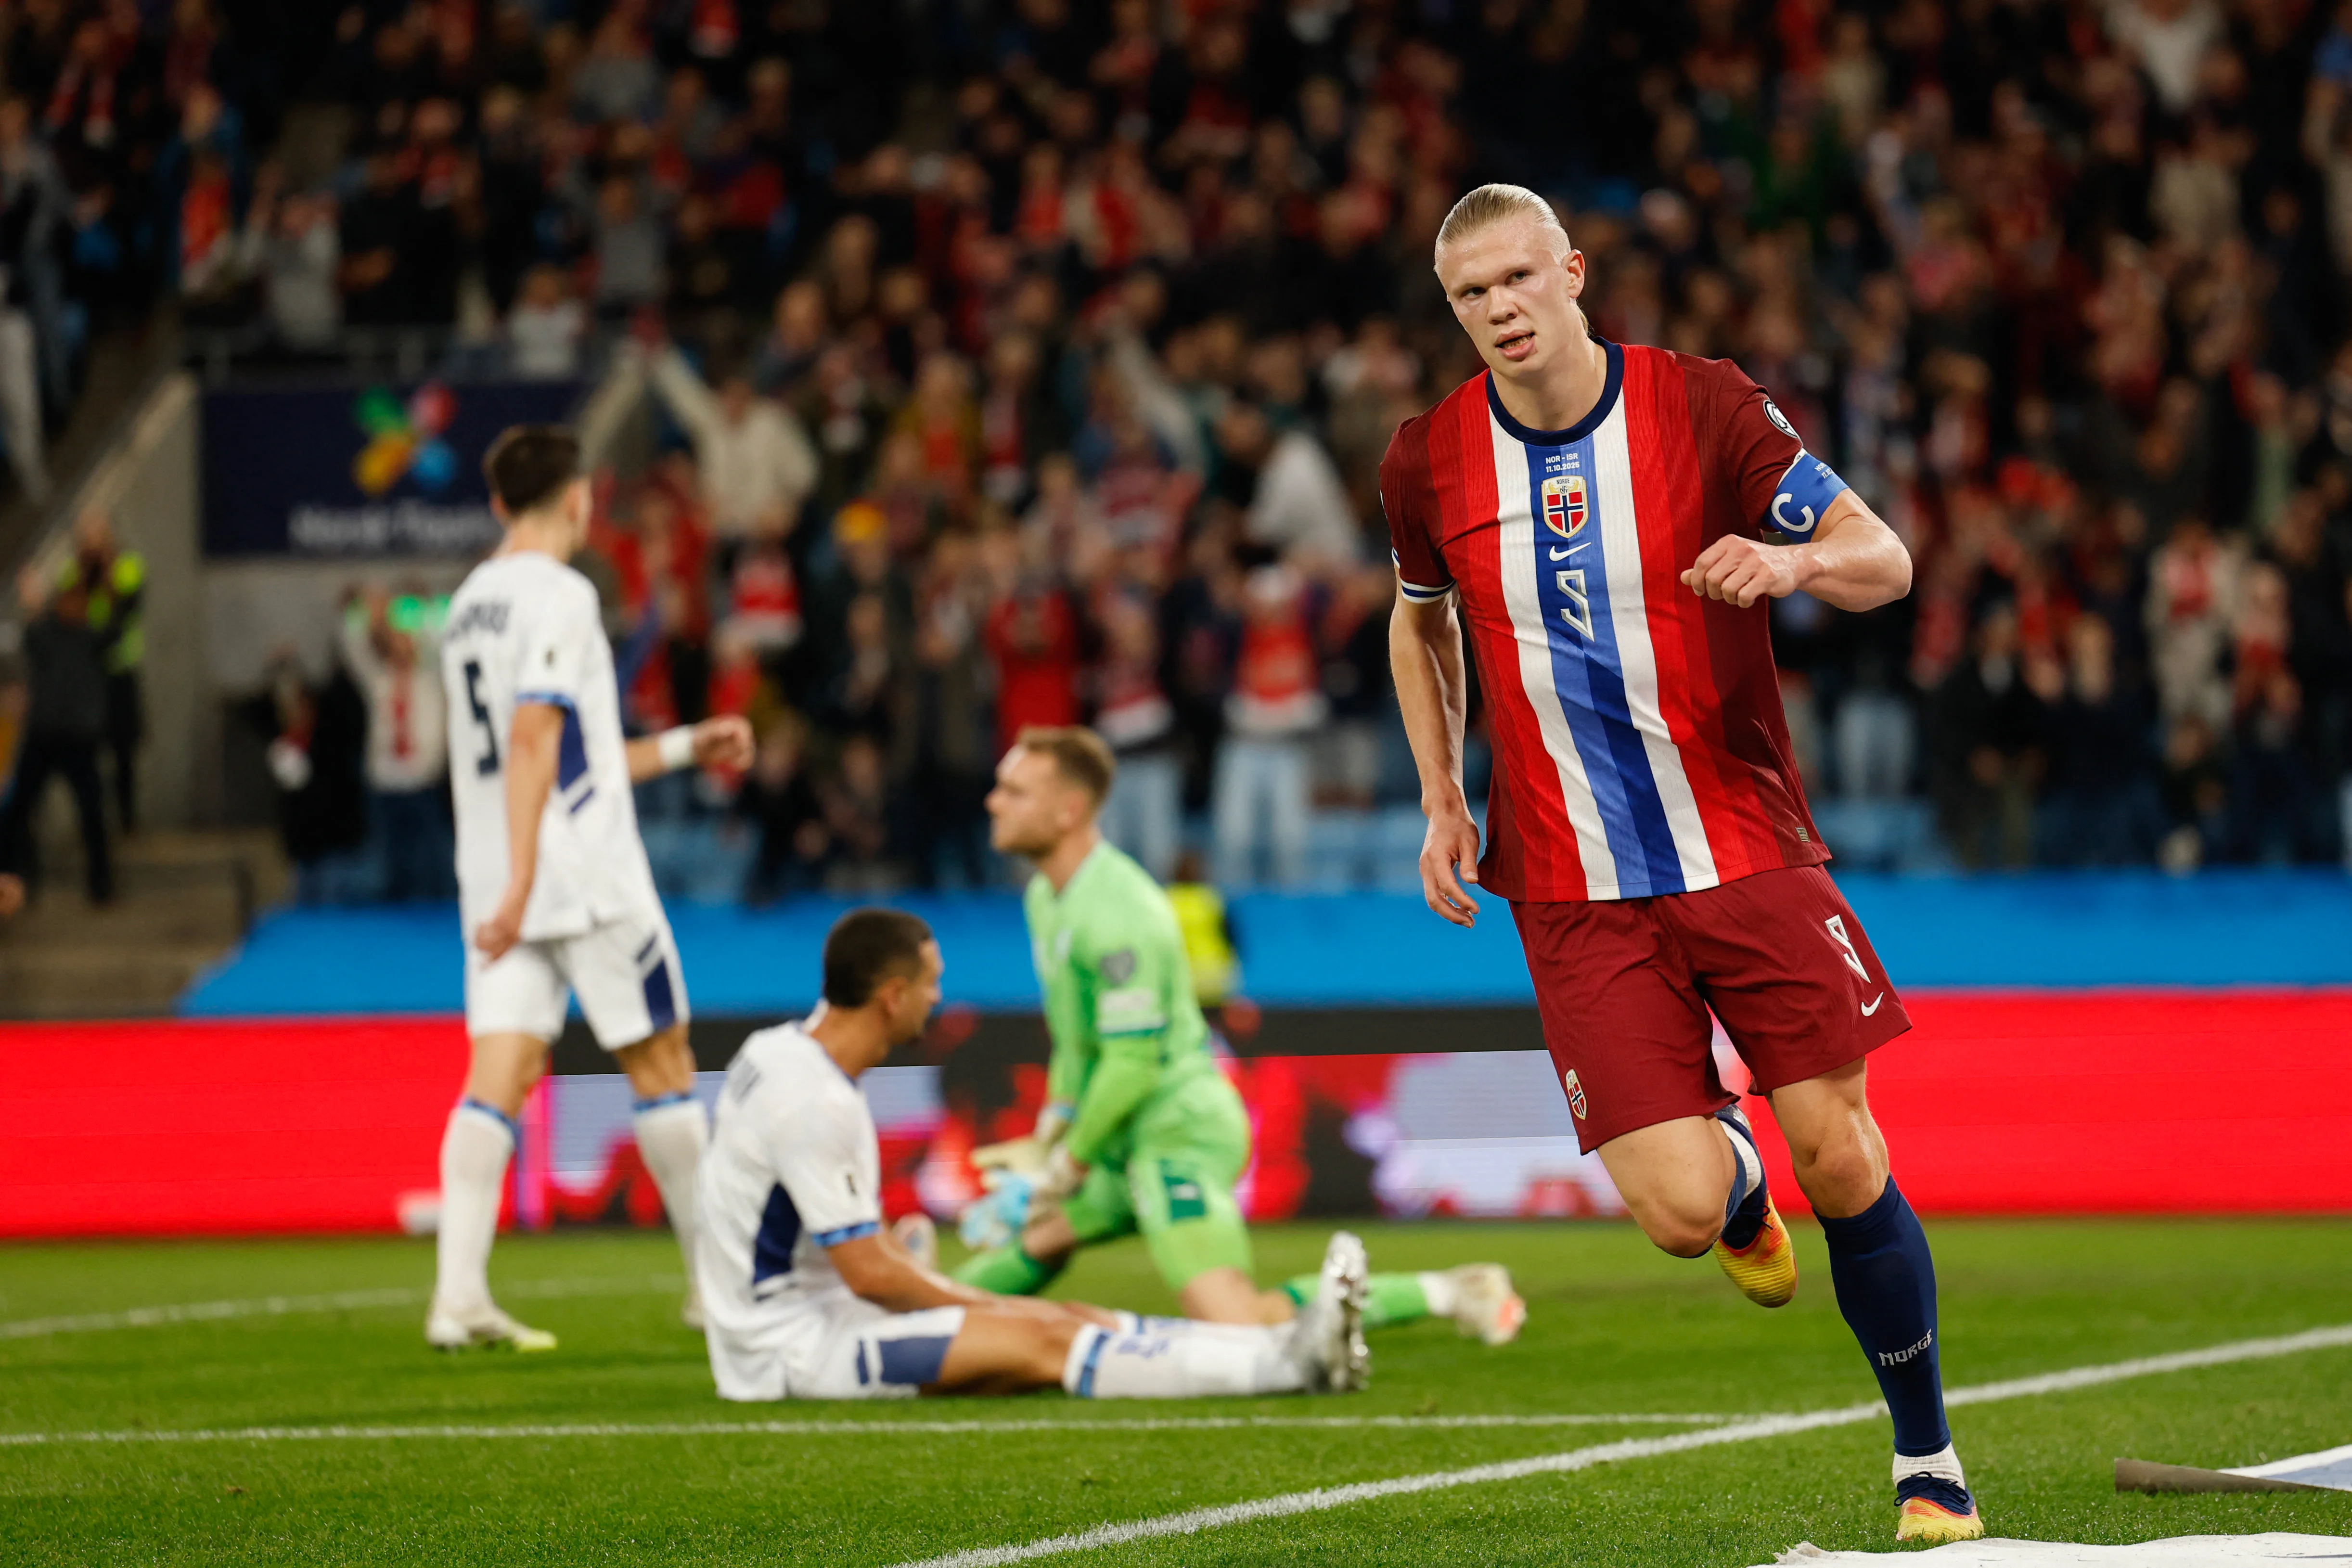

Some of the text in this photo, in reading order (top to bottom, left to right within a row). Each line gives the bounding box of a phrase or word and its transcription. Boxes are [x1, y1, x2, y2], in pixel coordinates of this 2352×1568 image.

[1545, 455, 1560, 464] NOR
[1566, 452, 1578, 461] ISR
[1545, 461, 1580, 473] 11.10.2025
[1771, 493, 1814, 532] C
[1555, 569, 1594, 642] 9
[463, 659, 500, 774] 5
[1878, 1328, 1932, 1366] NORGE
